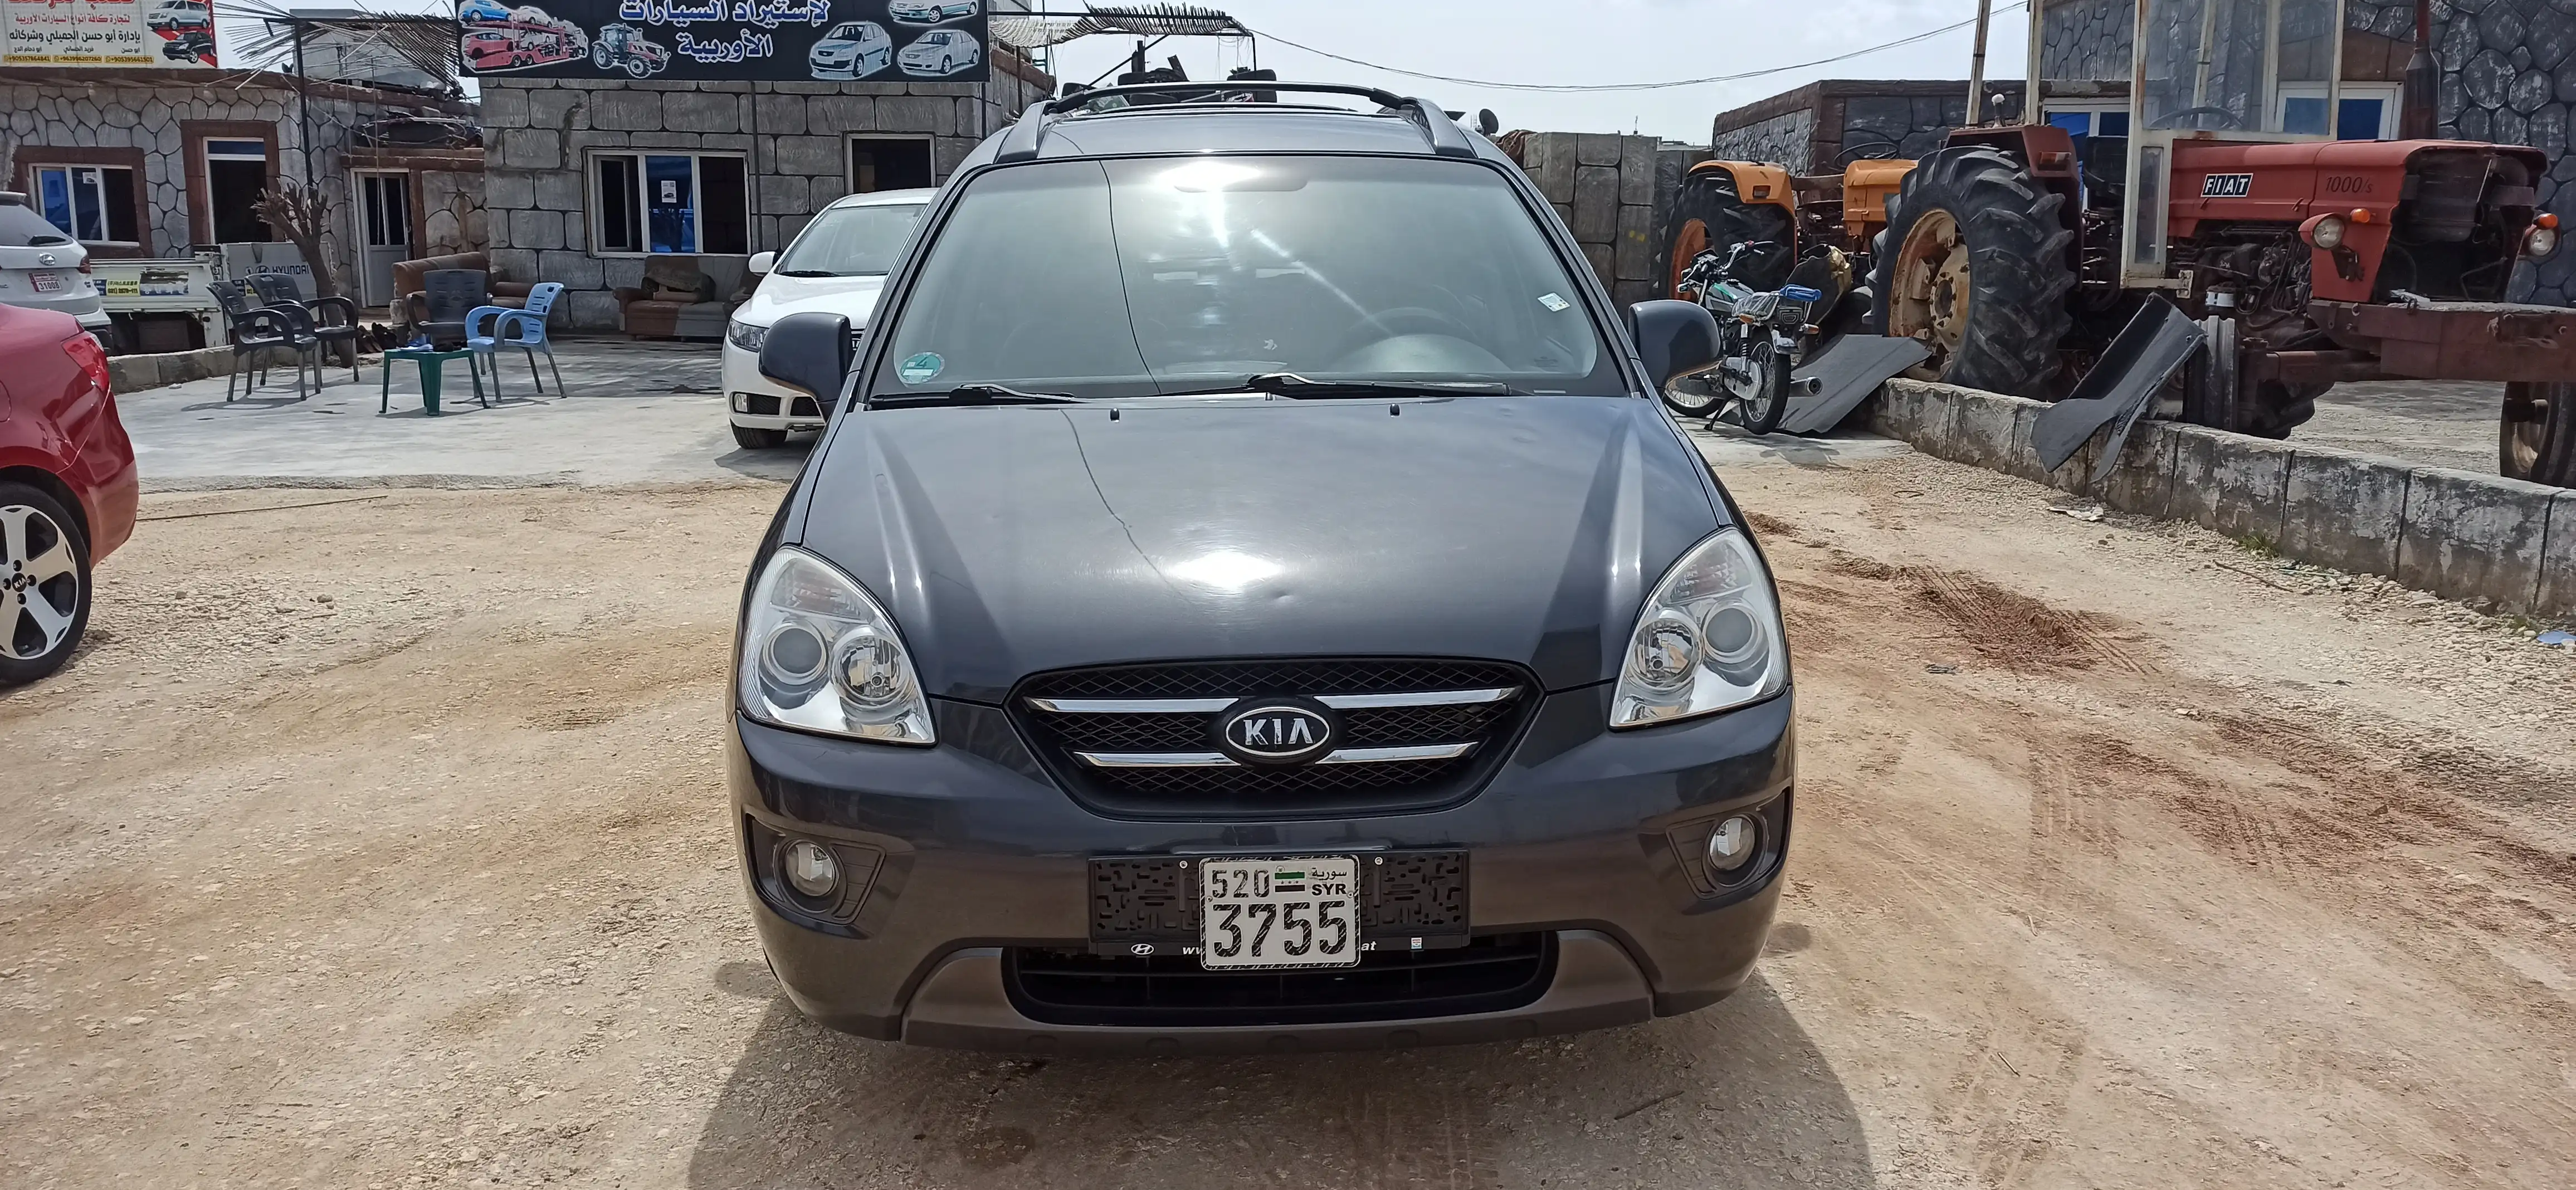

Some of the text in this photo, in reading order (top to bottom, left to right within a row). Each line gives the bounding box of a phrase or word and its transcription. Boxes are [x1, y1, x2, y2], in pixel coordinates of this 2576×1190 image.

[42, 13, 70, 25] السيارات
[70, 13, 87, 25] انواع
[88, 13, 108, 23] كافة
[110, 14, 130, 26] لتجارة
[619, 0, 728, 27] السيارات
[9, 28, 140, 45] بإدارة أبو حسن الجميلي وشركائه
[676, 28, 773, 62] الأوربية
[2204, 177, 2249, 193] FIAT
[2325, 175, 2374, 194] 1000/s
[272, 265, 309, 275] HYUNDAI
[916, 357, 928, 368] 4
[14, 577, 26, 588] KIA
[1243, 718, 1314, 746] KIA
[1311, 866, 1348, 881] سورية
[1212, 869, 1270, 898] 520
[1311, 883, 1348, 896] SYR
[1212, 900, 1348, 957] 3755
